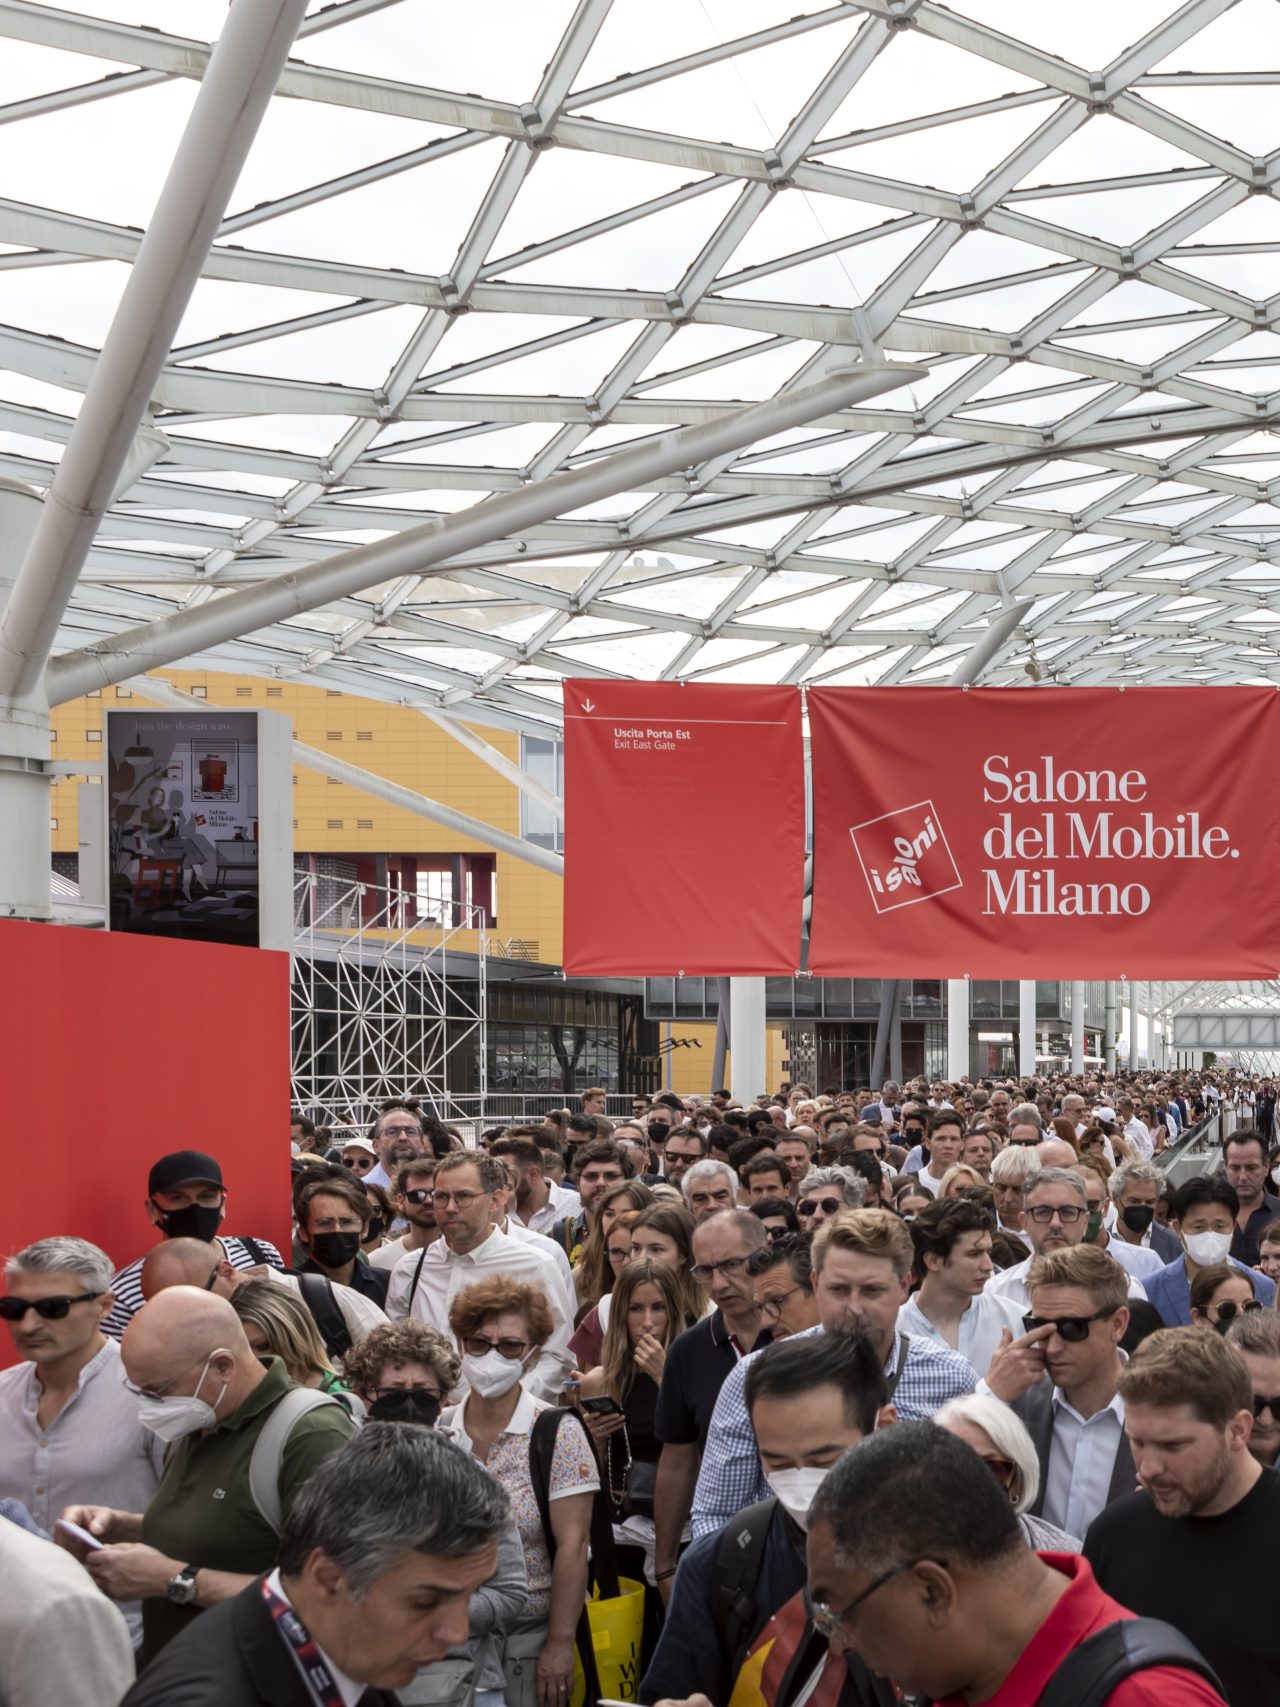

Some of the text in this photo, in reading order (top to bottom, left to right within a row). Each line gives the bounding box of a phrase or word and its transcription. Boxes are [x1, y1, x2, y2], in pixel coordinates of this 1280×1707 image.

[157, 720, 173, 730] the
[175, 721, 207, 732] design
[210, 722, 233, 730] wave
[614, 728, 691, 740] Uscita Porta Est
[614, 739, 676, 751] Exit East Gate
[983, 755, 1147, 804] Salone
[983, 812, 1241, 861] del Mobile.
[981, 869, 1152, 917] Milano
